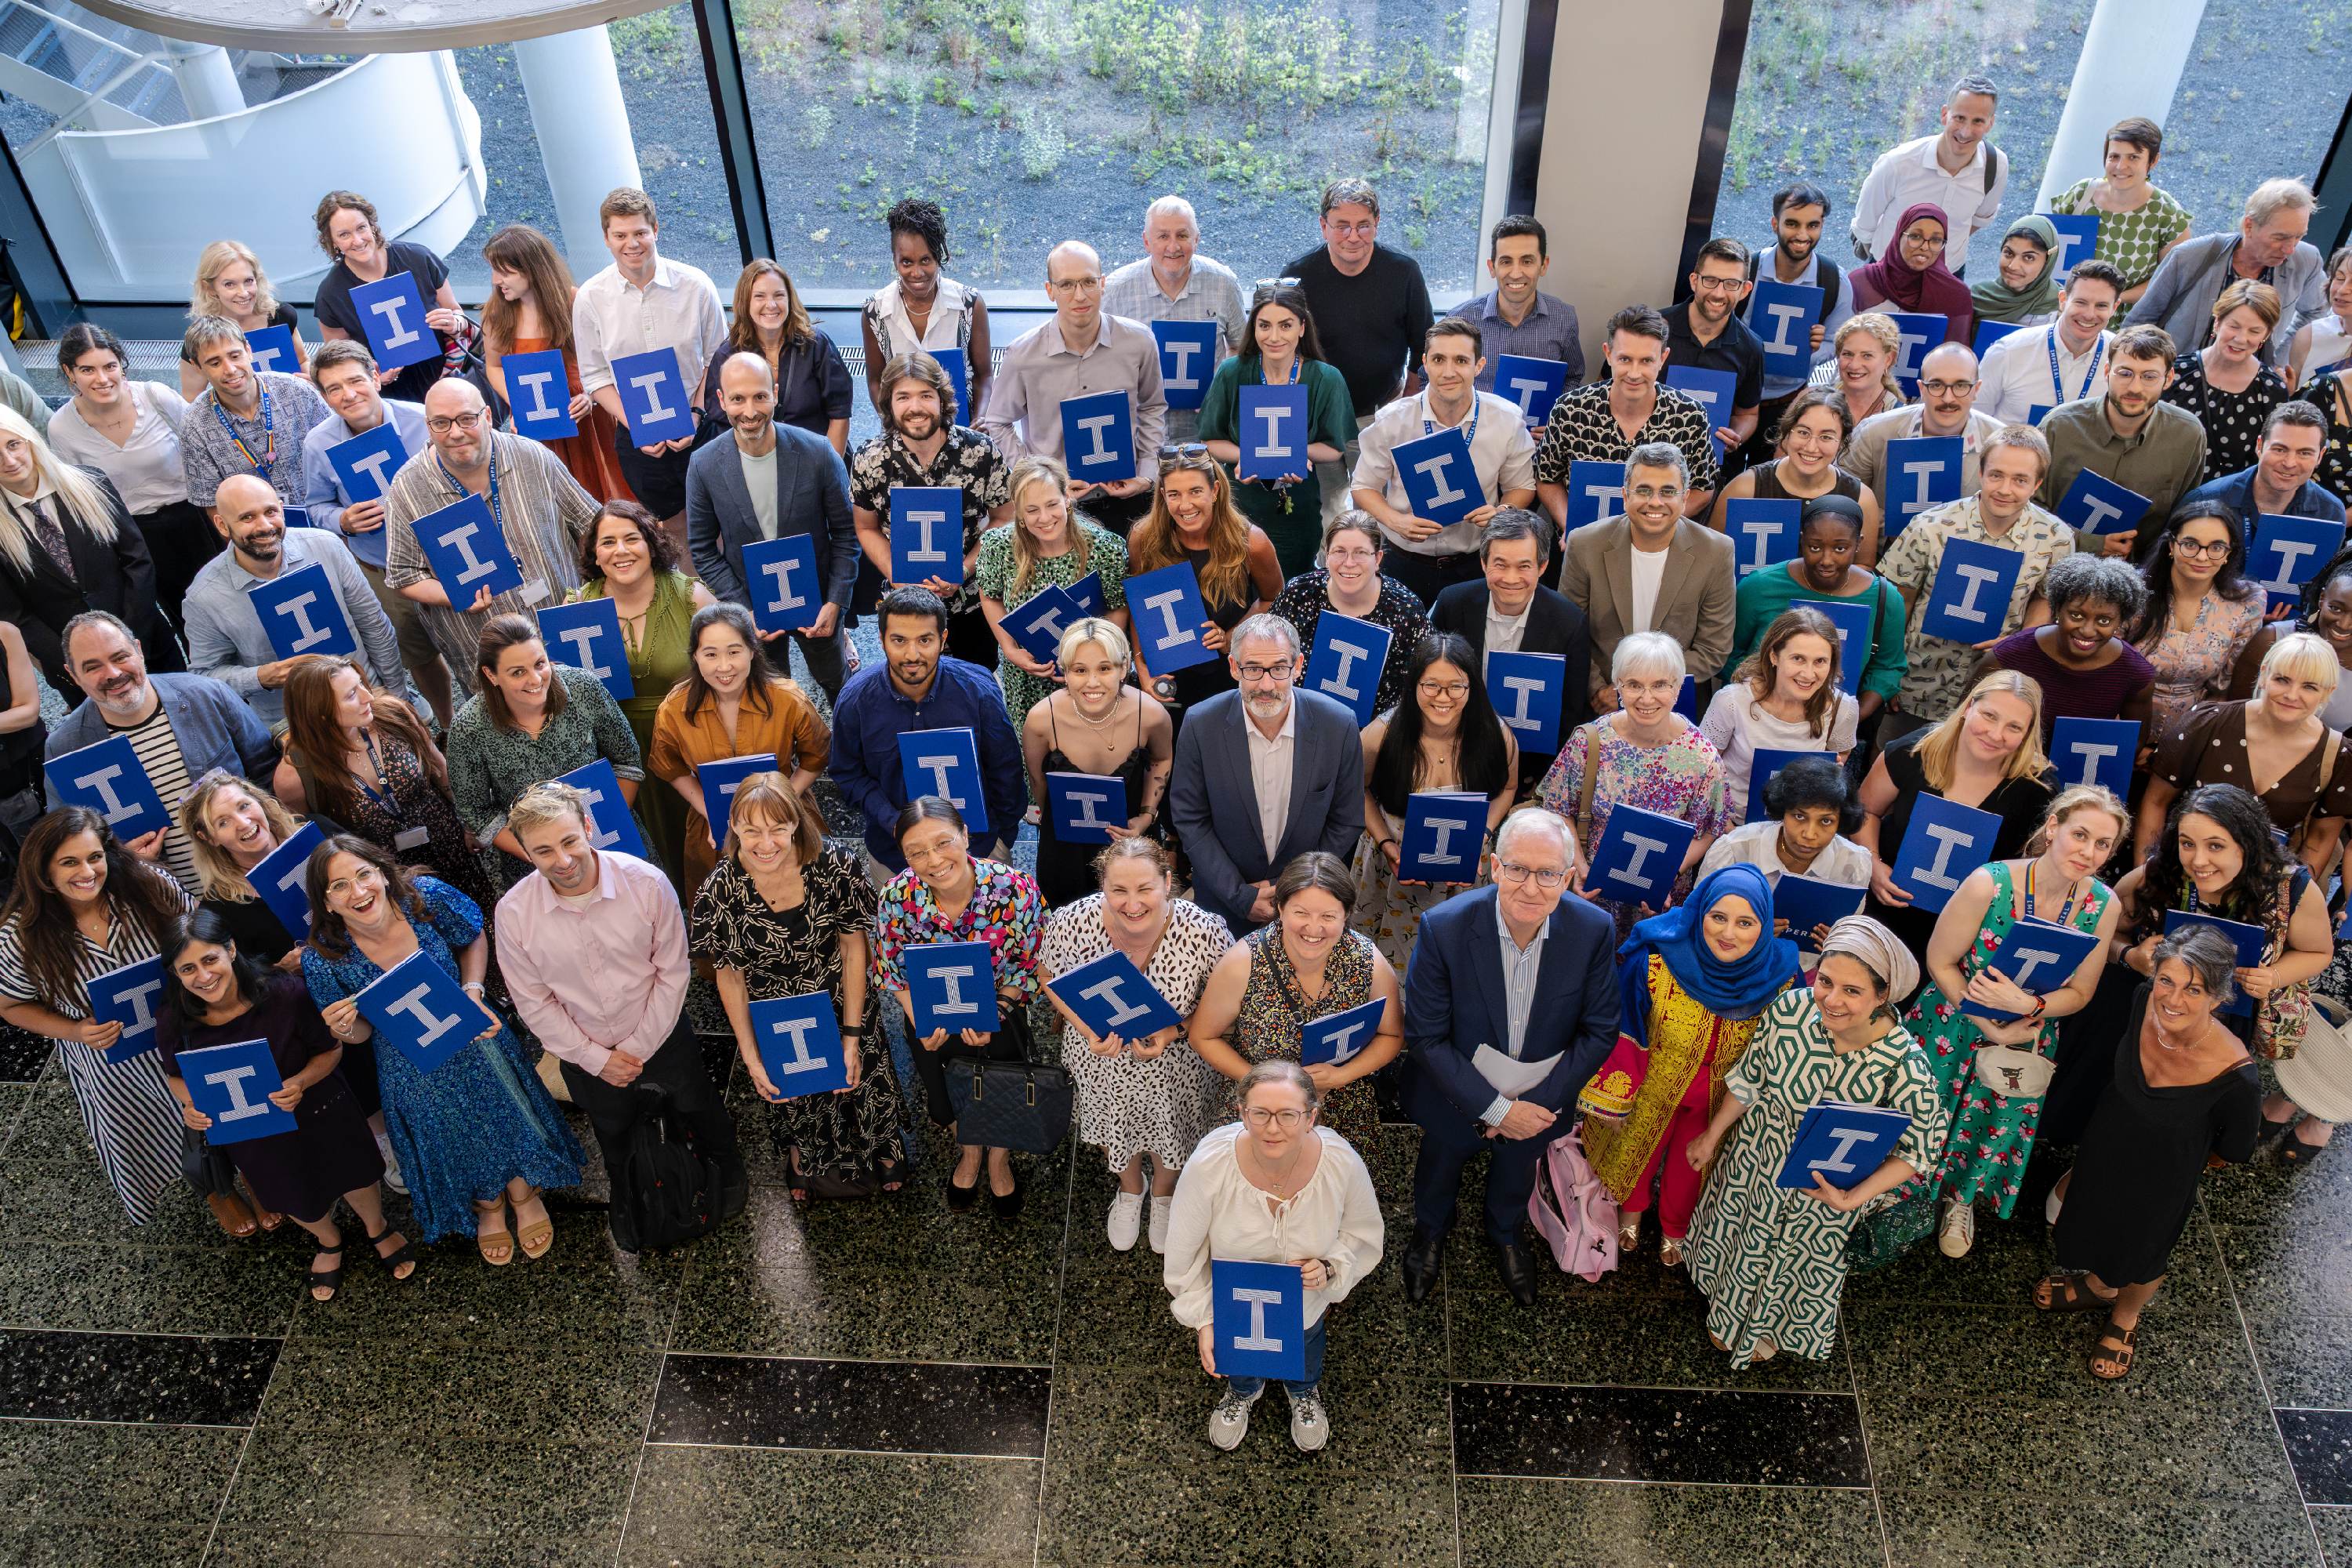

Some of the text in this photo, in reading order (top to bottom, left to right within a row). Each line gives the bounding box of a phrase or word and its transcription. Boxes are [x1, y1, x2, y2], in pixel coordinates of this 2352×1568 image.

[370, 296, 419, 350] I
[1764, 303, 1804, 355] I
[1165, 342, 1201, 390] I
[1897, 333, 1928, 378] I
[2050, 350, 2060, 379] IMPERIAL
[518, 372, 560, 421] I
[630, 371, 676, 424] I
[1511, 377, 1548, 426] I
[1078, 415, 1117, 465] I
[1254, 407, 1291, 457] I
[351, 449, 392, 502] I
[1414, 453, 1465, 509] I
[1902, 461, 1945, 514] I
[1586, 485, 1624, 521] I
[2082, 495, 2122, 532] I
[438, 522, 497, 585] I
[907, 511, 946, 561] I
[1740, 522, 1783, 574] I
[762, 559, 805, 612] I
[1944, 564, 1998, 622] I
[2259, 539, 2317, 595] I
[275, 591, 331, 652] I
[1025, 606, 1065, 657] I
[1145, 590, 1196, 650] I
[560, 625, 611, 679] I
[1320, 639, 1368, 700] I
[1501, 676, 1545, 731] I
[918, 755, 966, 808] I
[2065, 742, 2118, 787] I
[74, 764, 143, 825] I
[576, 787, 620, 849] I
[1066, 792, 1110, 827] I
[1419, 818, 1466, 863] I
[1610, 832, 1667, 888] I
[1911, 823, 1973, 891] I
[927, 966, 978, 1014] I
[2013, 947, 2060, 996] I
[113, 979, 161, 1039] I
[386, 982, 461, 1047] I
[1080, 976, 1151, 1026] I
[773, 1018, 827, 1074] I
[1322, 1020, 1364, 1064] I
[205, 1066, 269, 1122] I
[1807, 1128, 1878, 1172] I
[1233, 1288, 1282, 1352] I
